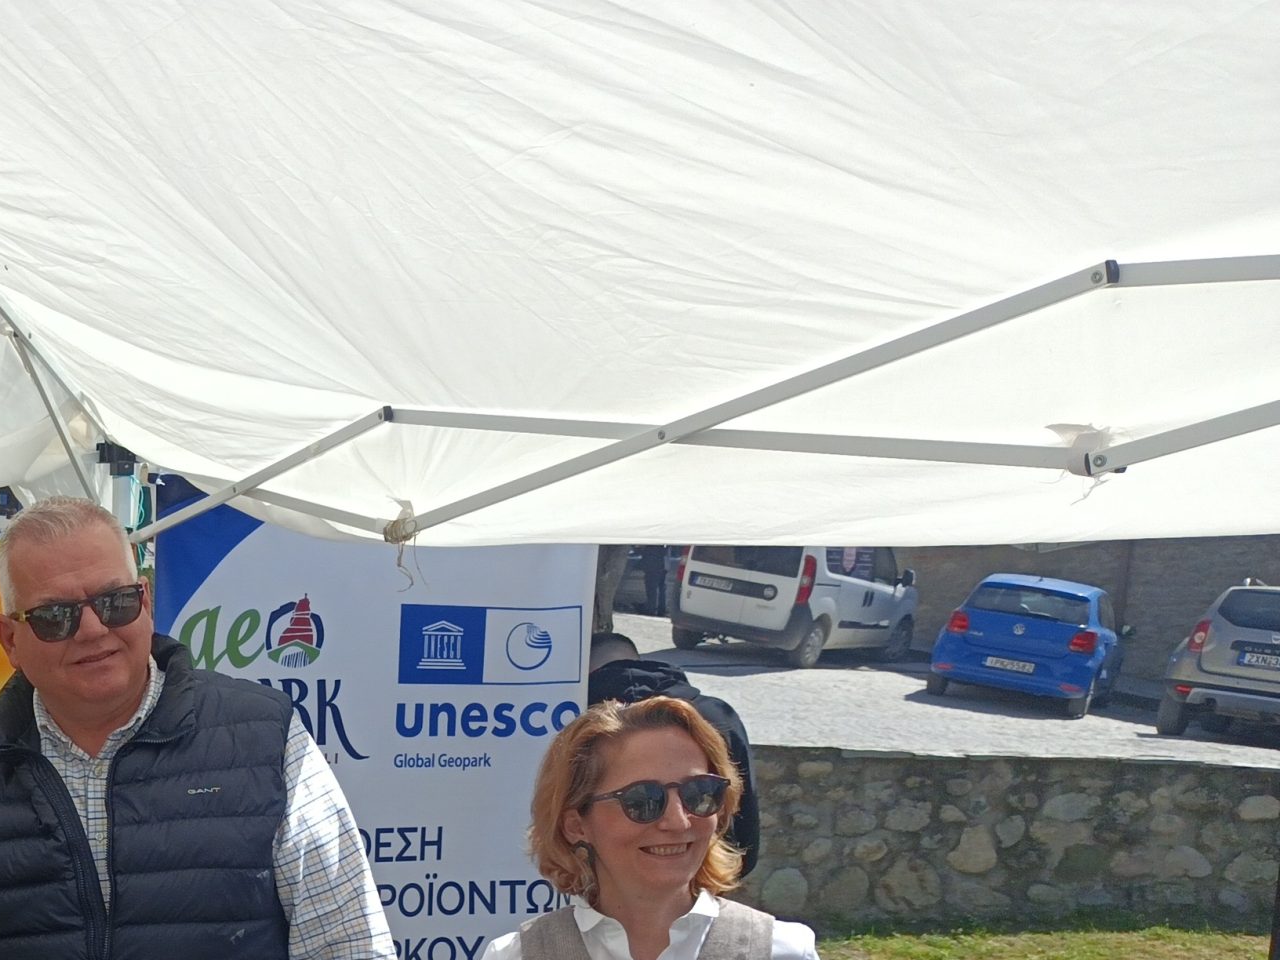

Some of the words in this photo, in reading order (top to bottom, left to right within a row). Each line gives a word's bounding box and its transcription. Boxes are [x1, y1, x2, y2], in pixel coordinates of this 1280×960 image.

[395, 701, 581, 738] unesco
[393, 753, 435, 768] Global
[438, 753, 492, 771] Geopark
[187, 787, 221, 795] GANT
